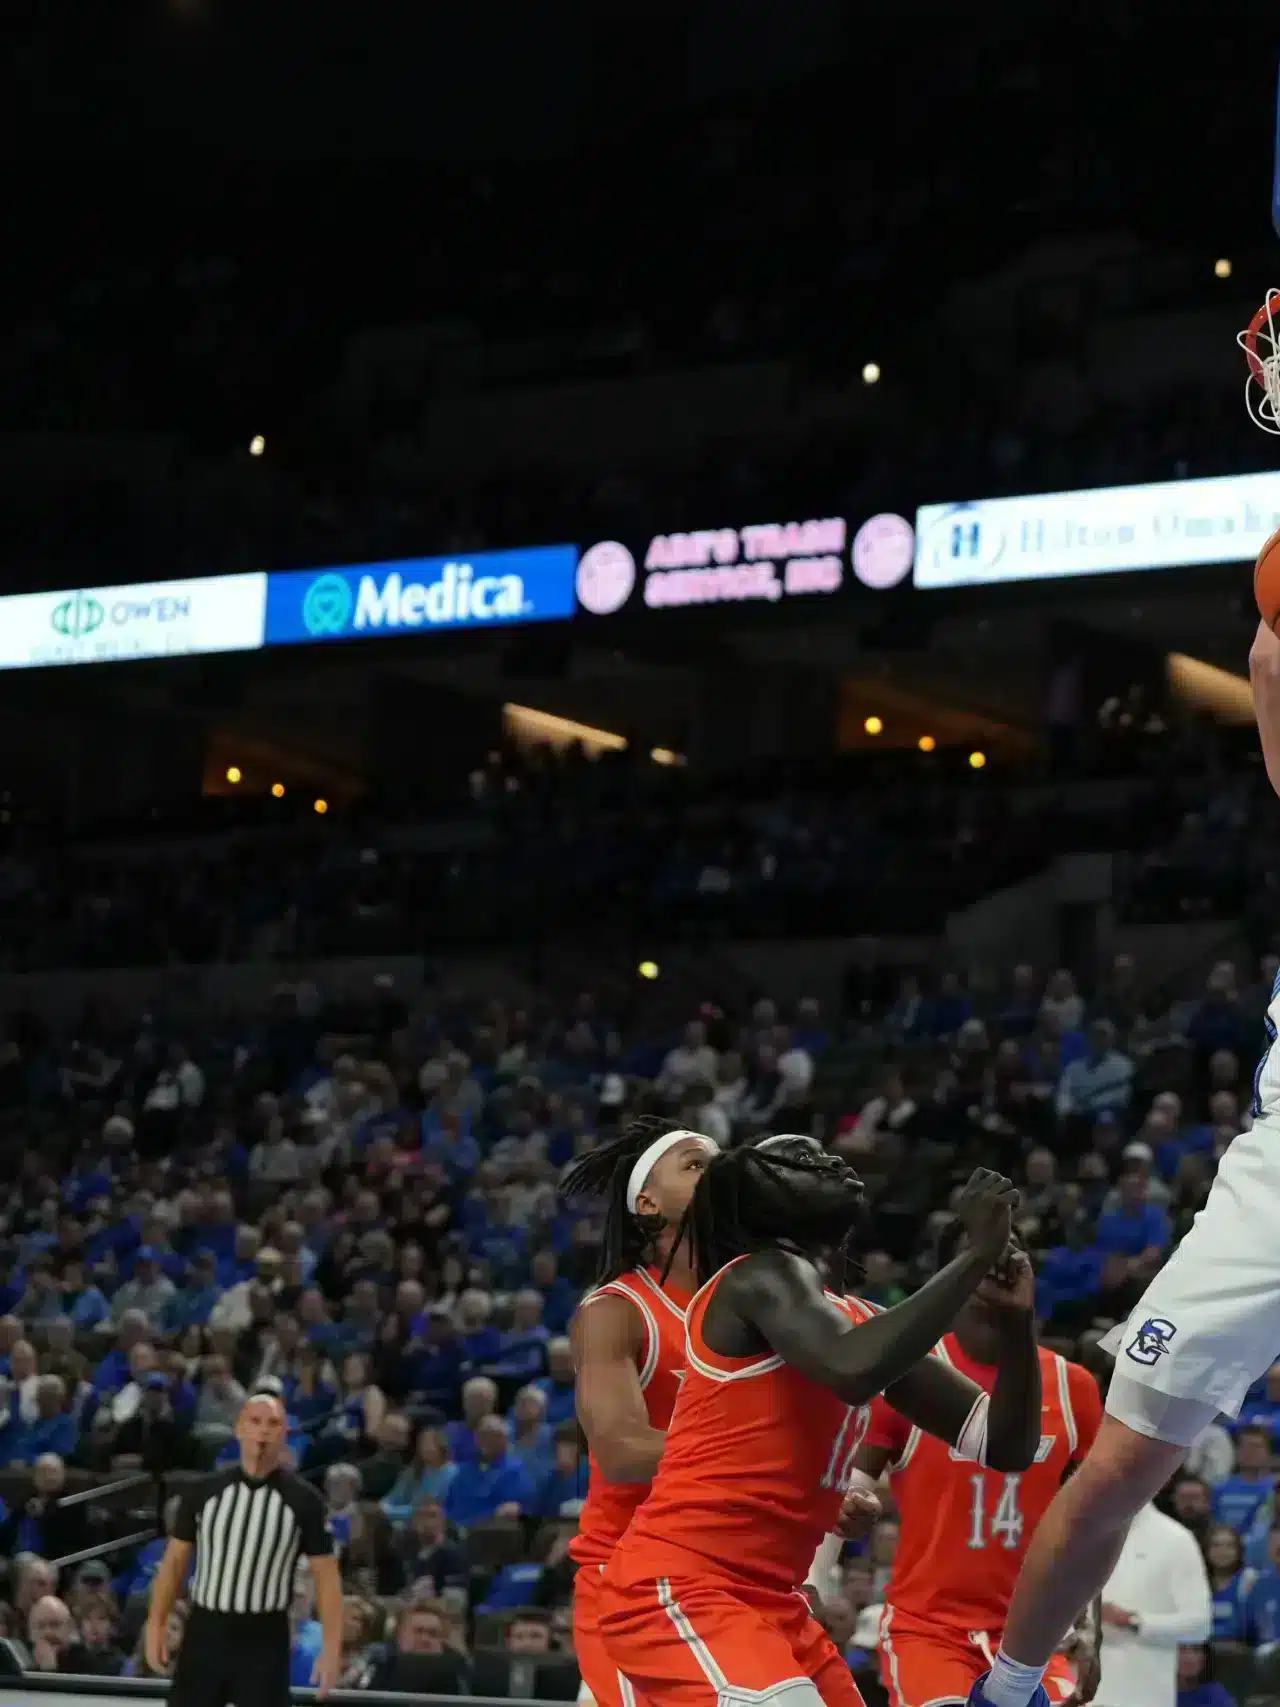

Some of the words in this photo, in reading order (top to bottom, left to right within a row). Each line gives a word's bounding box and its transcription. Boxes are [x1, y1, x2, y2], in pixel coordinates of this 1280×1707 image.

[110, 596, 191, 627] OWEN
[353, 562, 524, 630] Medica
[968, 1472, 1024, 1549] 14
